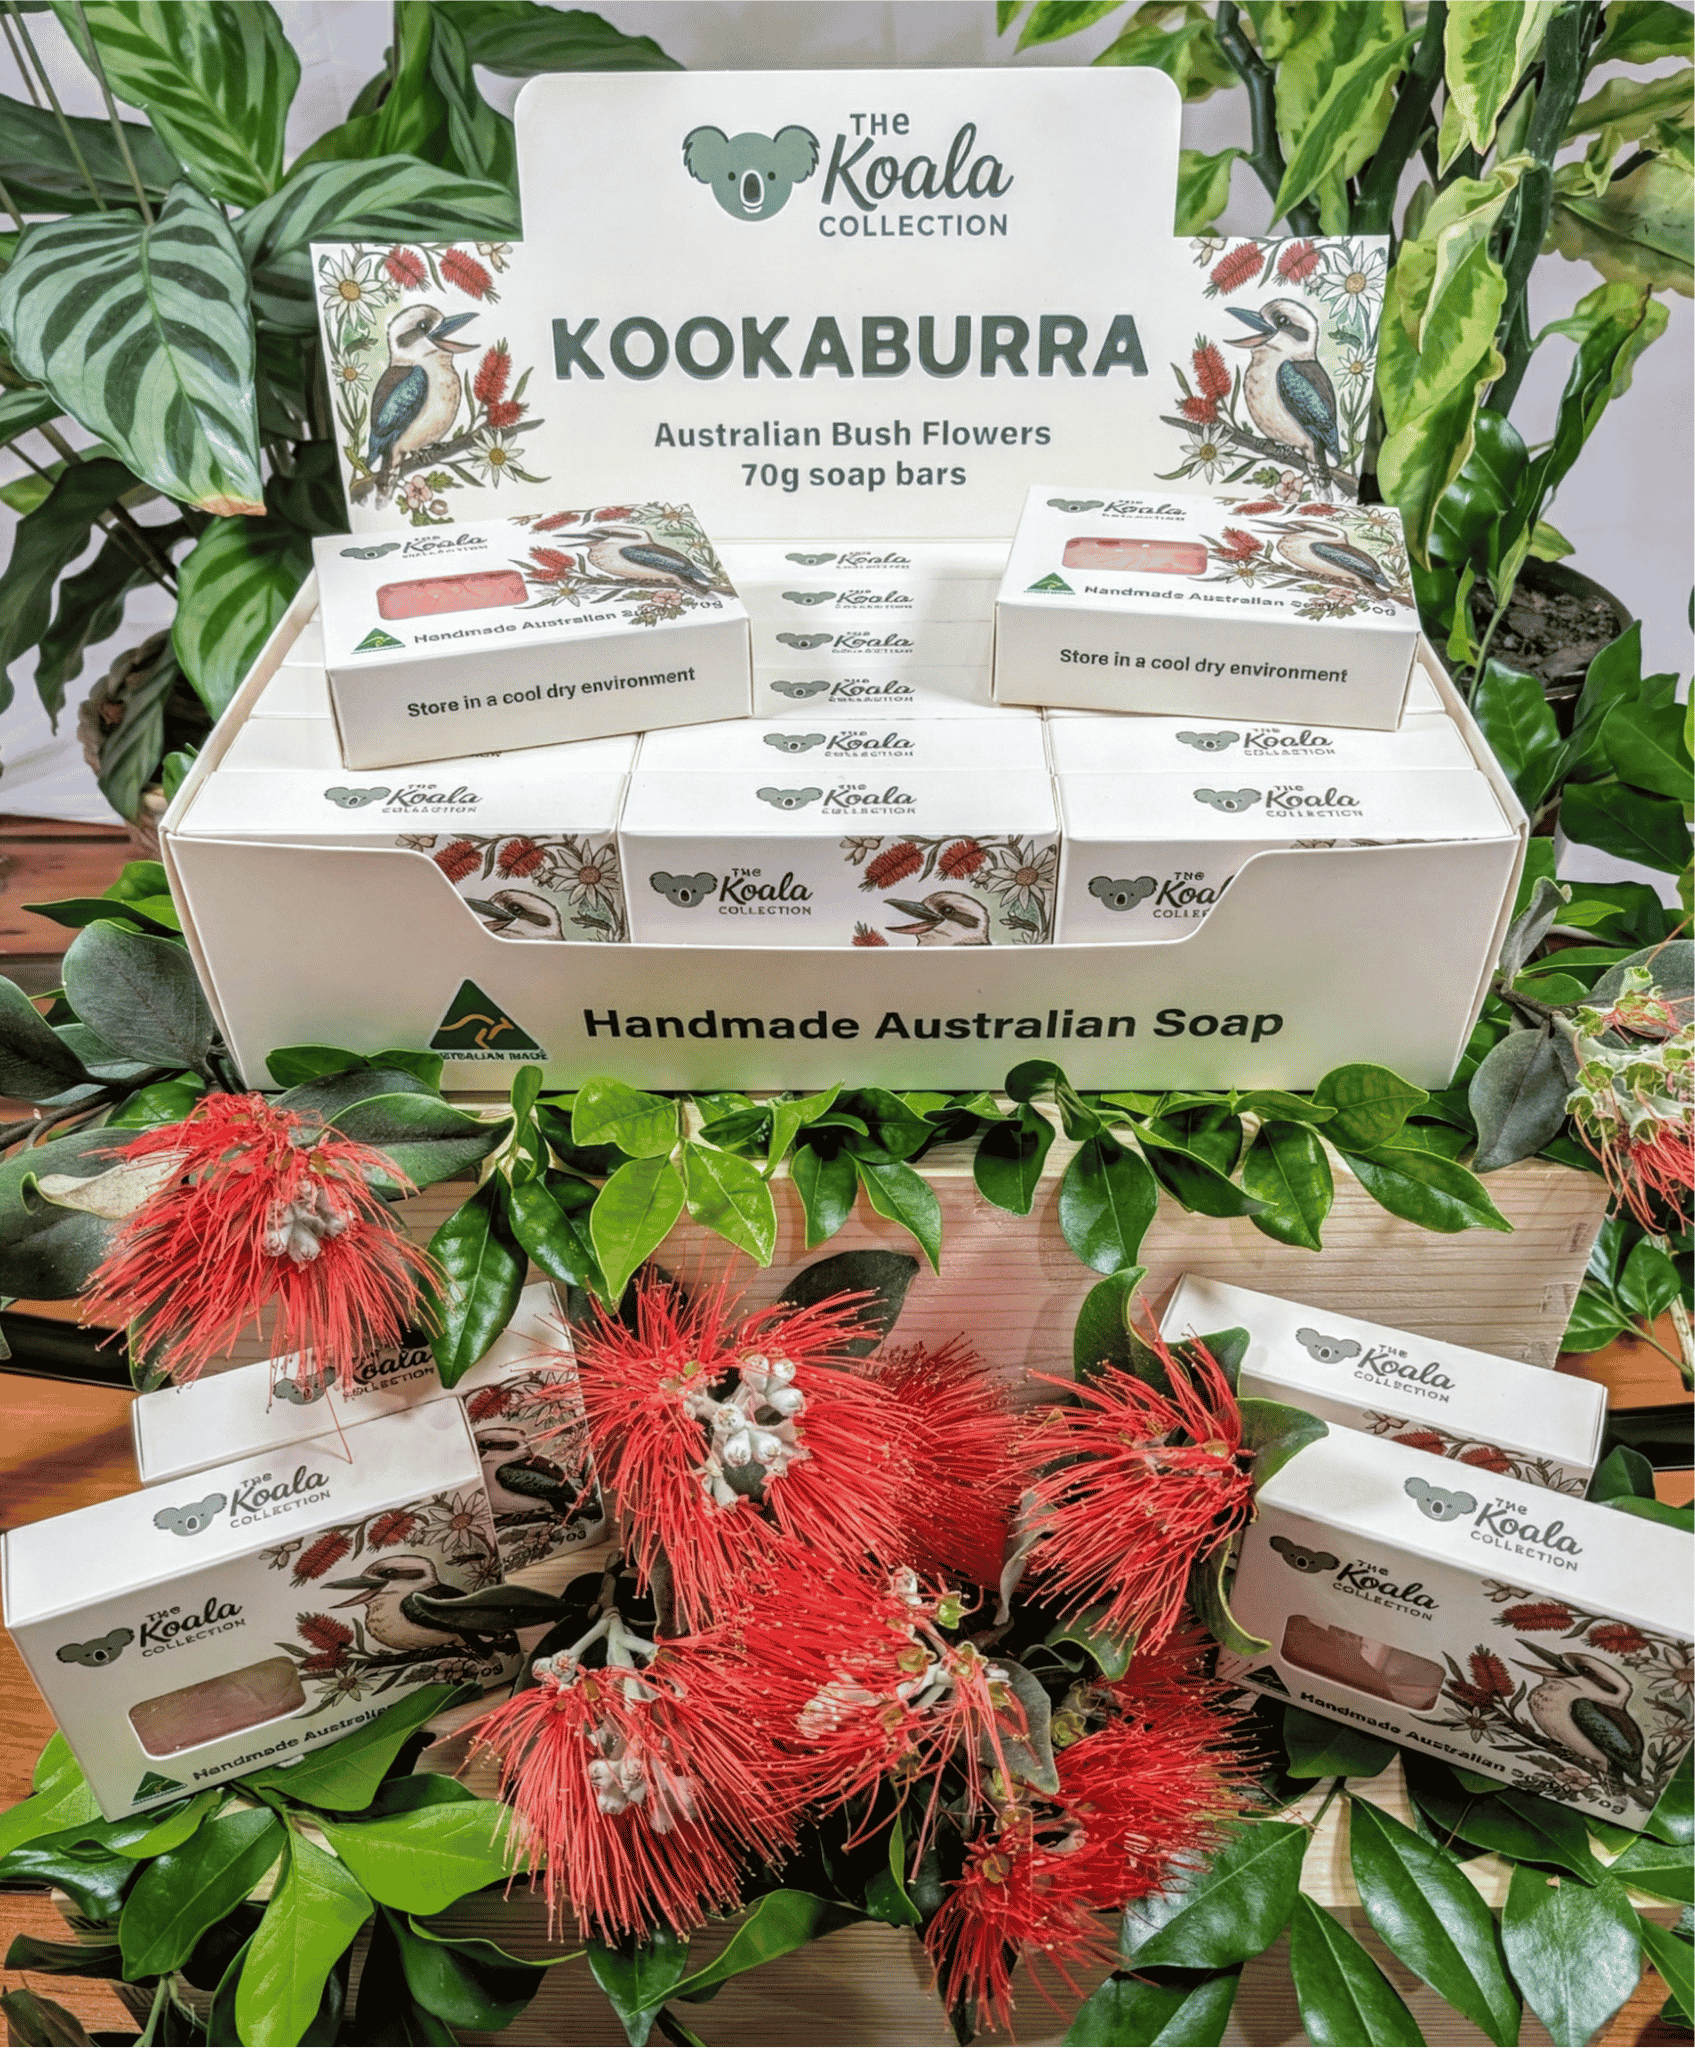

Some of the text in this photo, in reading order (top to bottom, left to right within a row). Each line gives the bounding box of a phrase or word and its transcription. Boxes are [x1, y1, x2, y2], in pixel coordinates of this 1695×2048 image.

[821, 122, 1014, 212] Koala
[819, 214, 1007, 237] COLLECTION
[551, 314, 1149, 380] KOOKABURRA
[654, 421, 1052, 446] Australian Bush Flowers
[741, 461, 967, 492] 70g soap bars
[835, 590, 914, 605] Koala
[1084, 586, 1184, 600] Handmade
[1189, 592, 1285, 607] Australian
[413, 625, 518, 644] Handmade
[522, 612, 617, 630] Australian
[832, 633, 915, 649] Koala
[1059, 648, 1348, 683] Store in a cool dry environment
[407, 666, 696, 718] Store in a cool dry environment
[829, 680, 915, 697] Koala
[825, 732, 915, 751] Koala
[1243, 729, 1333, 750] Koala
[386, 786, 484, 808] Koala
[823, 786, 917, 809] Koala
[1265, 787, 1361, 810] Koala
[718, 871, 814, 905] Koala
[718, 906, 812, 915] COLLECTION
[583, 1008, 1284, 1043] Handmade Australian Soap
[1357, 1347, 1456, 1390] Koala
[1353, 1370, 1450, 1403] COLLECTION
[229, 1465, 330, 1517] Koala
[229, 1490, 331, 1528] COLLECTION
[1473, 1502, 1583, 1556] Koala
[1470, 1530, 1579, 1572] COLLECTION
[1332, 1582, 1433, 1621] COLLECTION
[1336, 1563, 1440, 1610] Koala
[140, 1596, 243, 1648] Koala
[141, 1618, 246, 1658] COLLECTION
[1300, 1691, 1402, 1734] Handmade
[1404, 1731, 1506, 1772] Australian
[192, 1737, 300, 1781] Handmade
